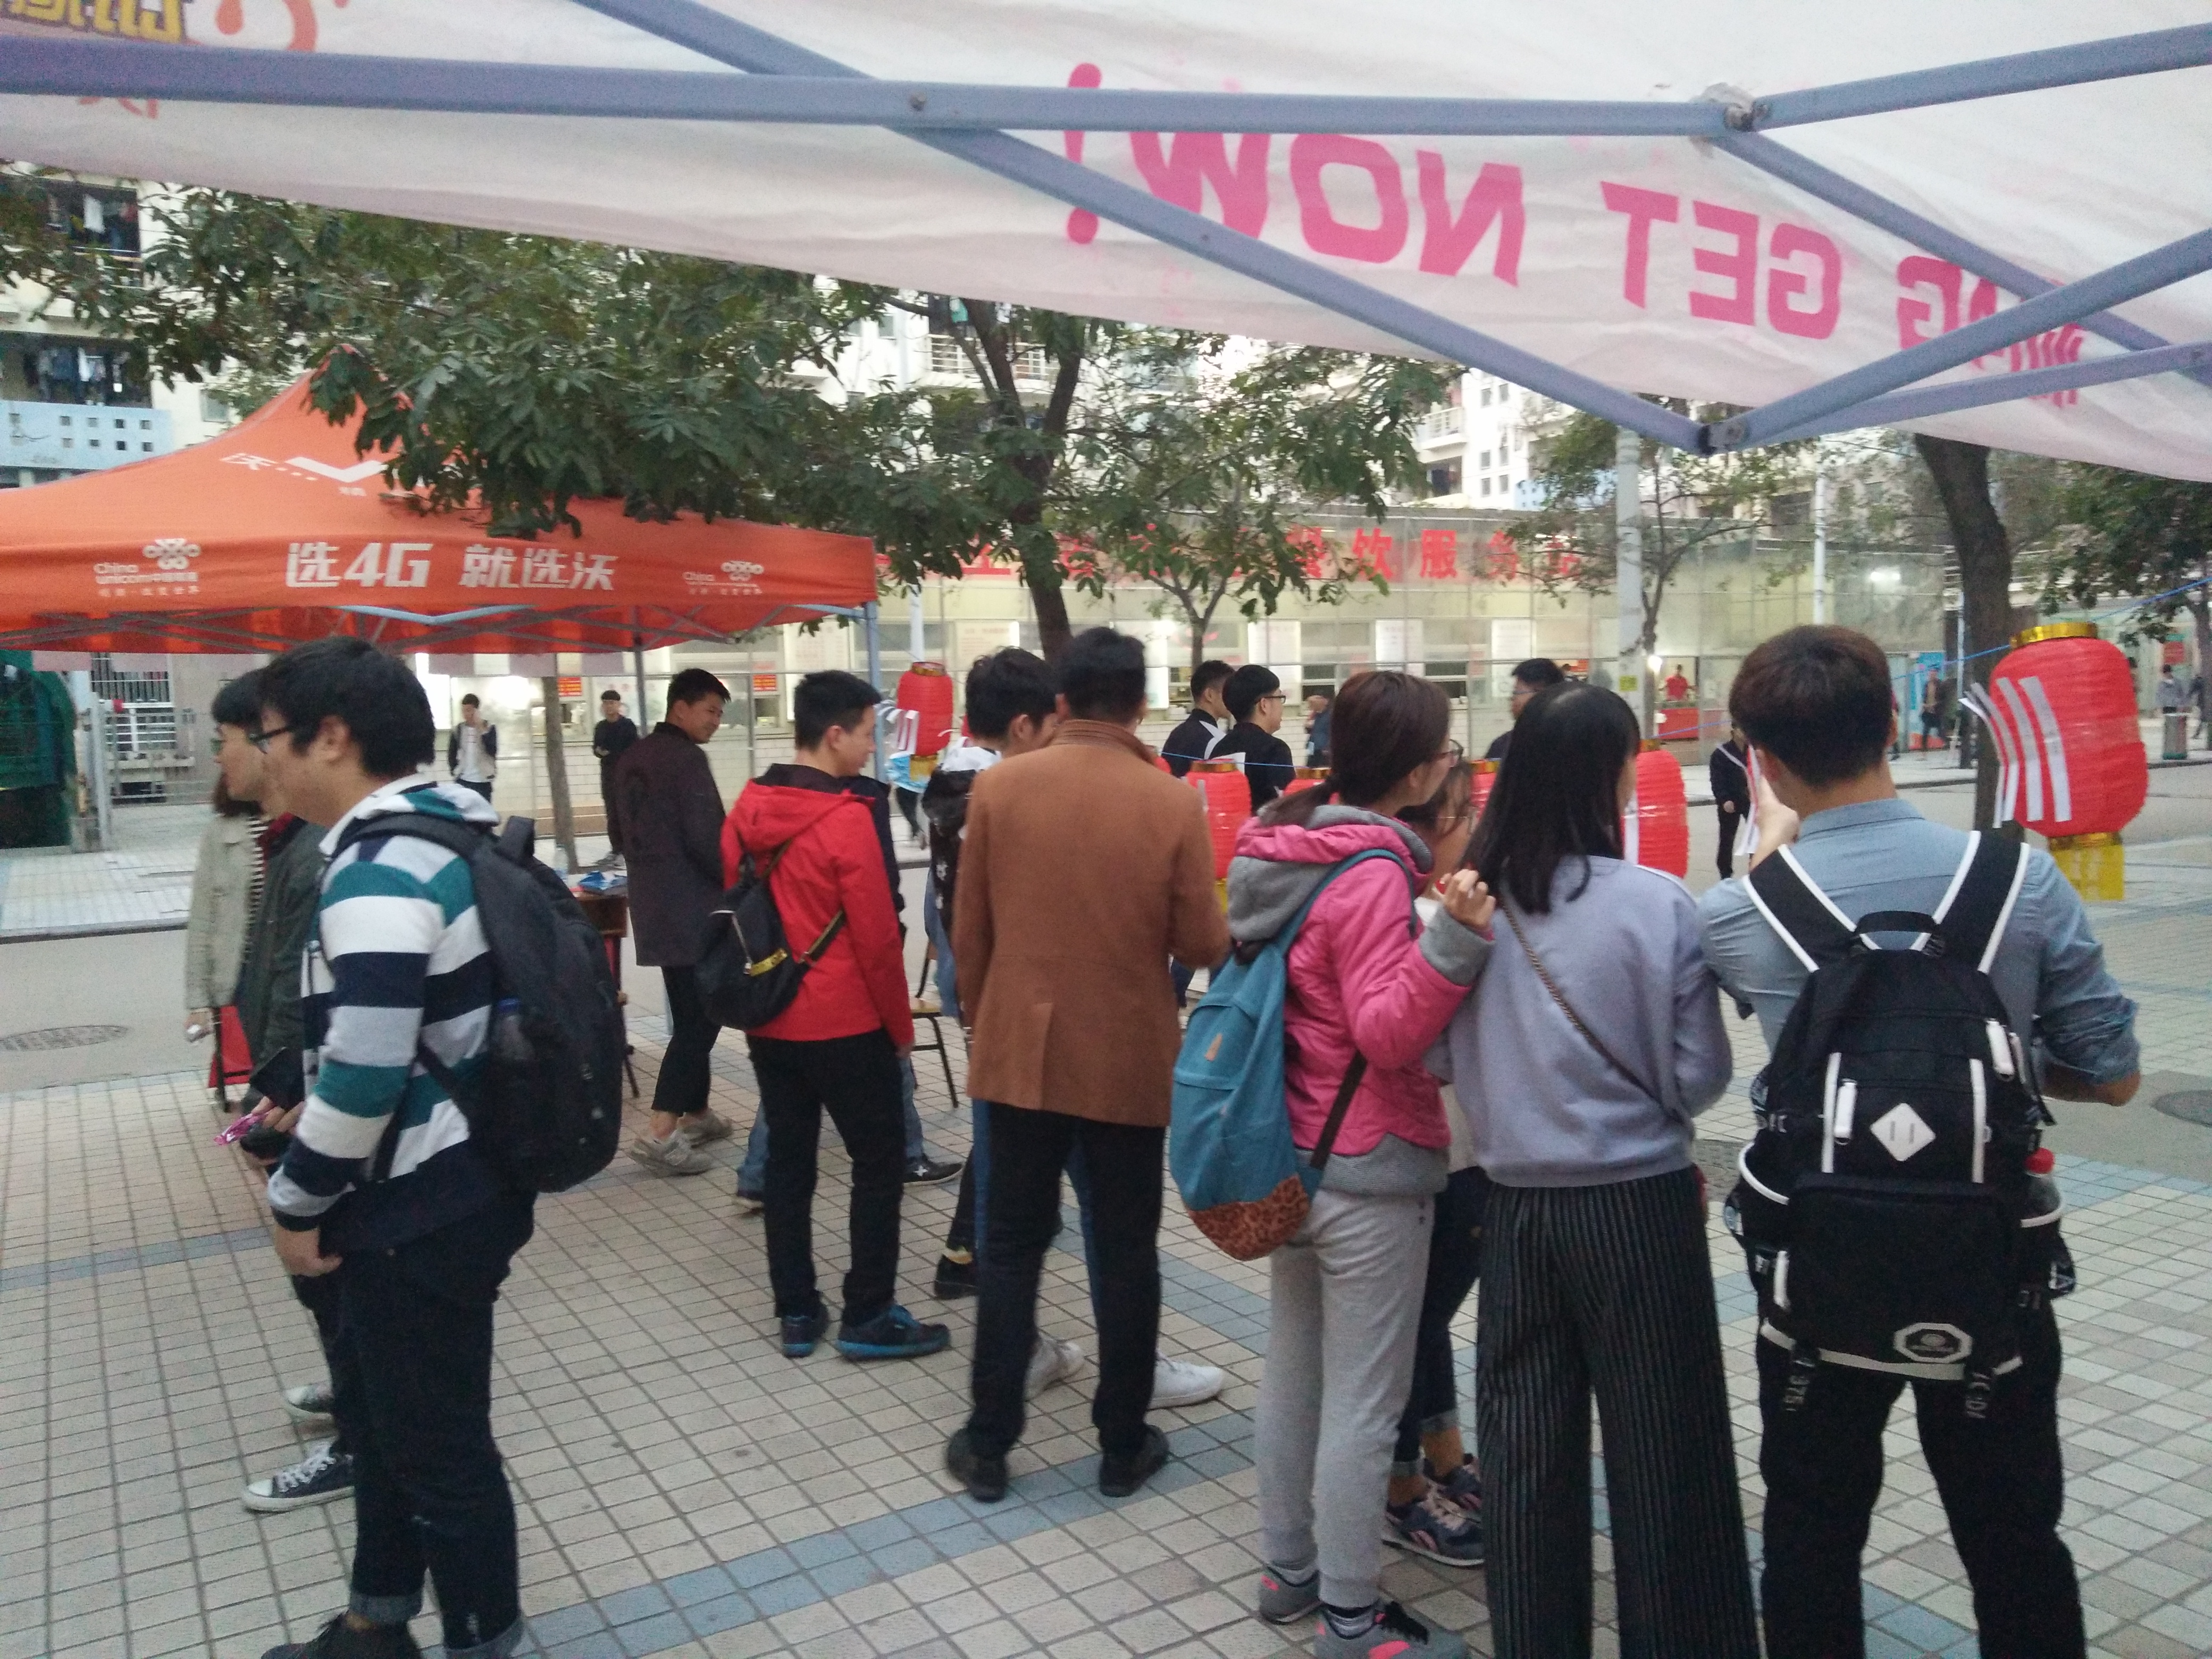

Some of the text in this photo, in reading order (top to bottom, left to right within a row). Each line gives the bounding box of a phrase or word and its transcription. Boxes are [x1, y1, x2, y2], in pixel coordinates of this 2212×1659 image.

[286, 542, 618, 591] 选4G 就选沃
